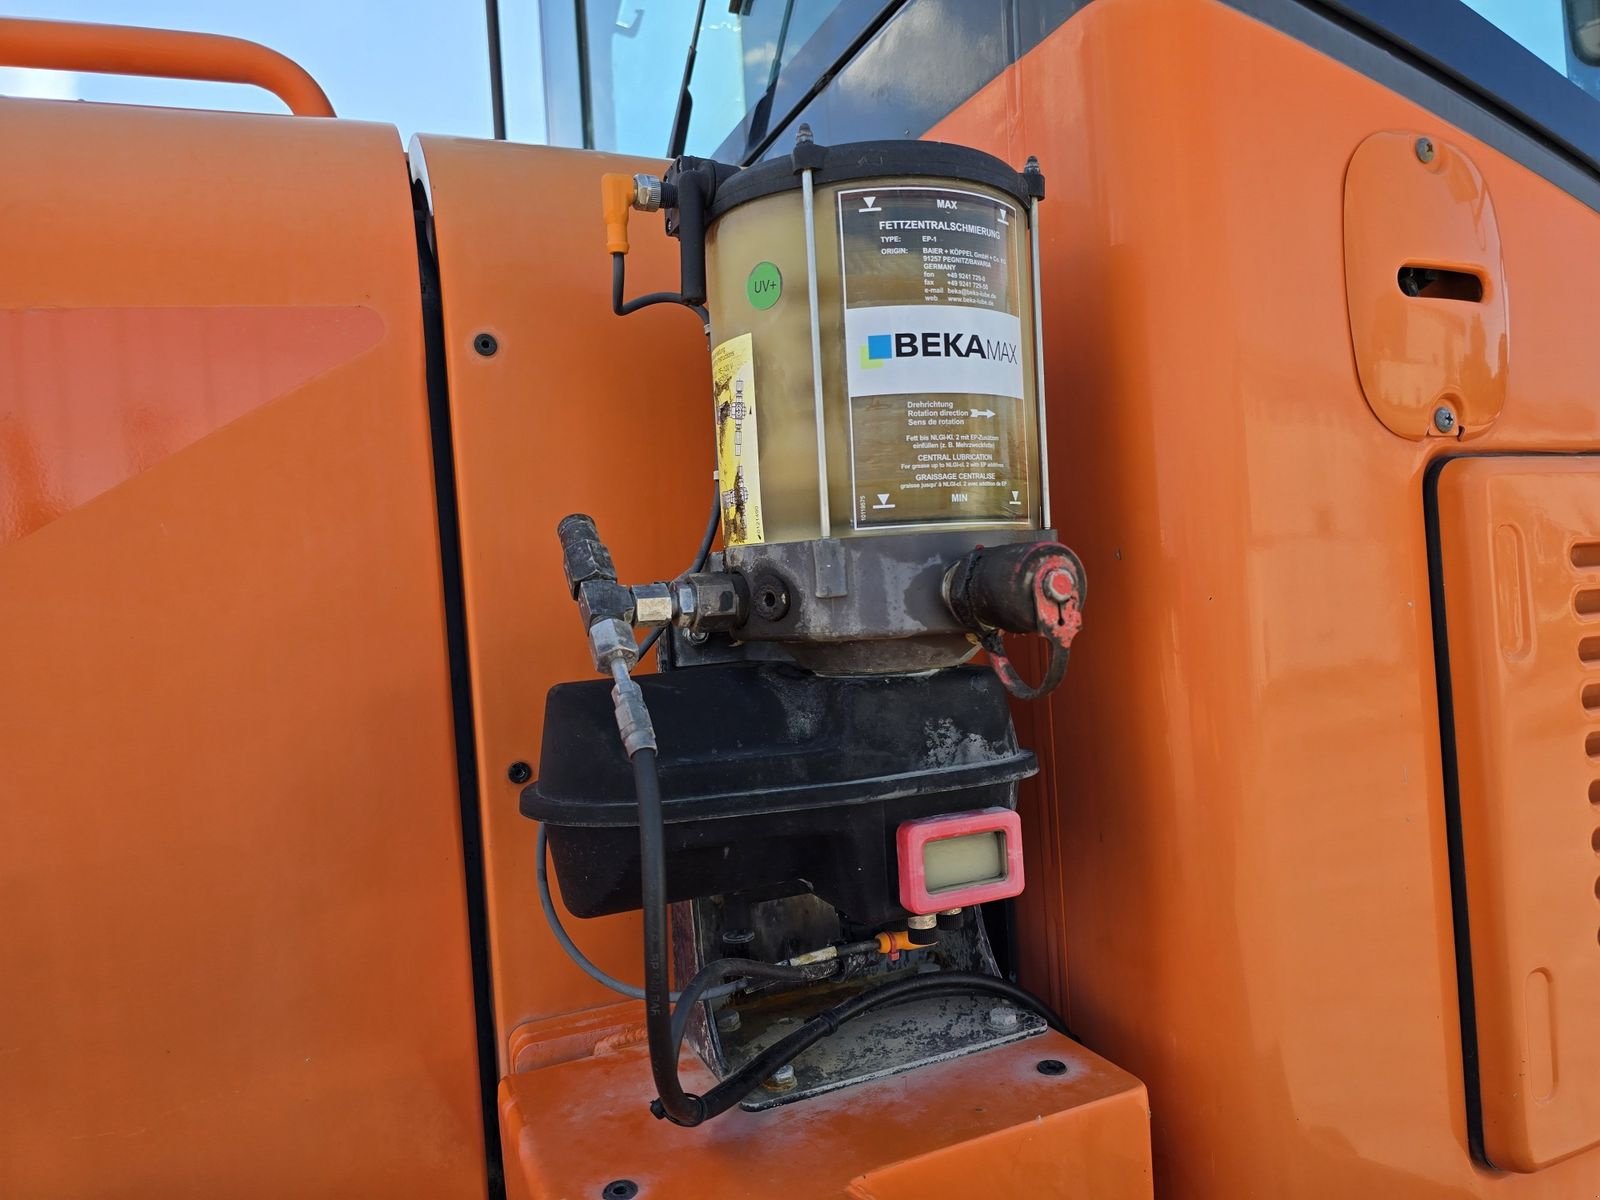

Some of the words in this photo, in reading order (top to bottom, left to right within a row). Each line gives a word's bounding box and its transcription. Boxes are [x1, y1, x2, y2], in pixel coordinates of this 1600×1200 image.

[936, 199, 957, 209] MAX
[879, 220, 1001, 240] FETTZENTRALSCHMIERUNG
[881, 247, 908, 255] ORIGIN:
[949, 248, 974, 258] KÖPPEL
[973, 252, 989, 260] GmbH
[942, 256, 991, 268] PEGNITZ/BAVARIA
[923, 263, 957, 271] GERMANY
[754, 279, 776, 294] UV+
[907, 401, 954, 410] Drehrichtung
[907, 409, 938, 417] Rotation
[939, 409, 969, 417] direction
[907, 418, 926, 426] Sens
[952, 453, 992, 461] LUBRICATION
[915, 473, 957, 481] GRAISSAGE
[958, 472, 996, 480] CENTRALISE
[951, 493, 968, 503] MIN
